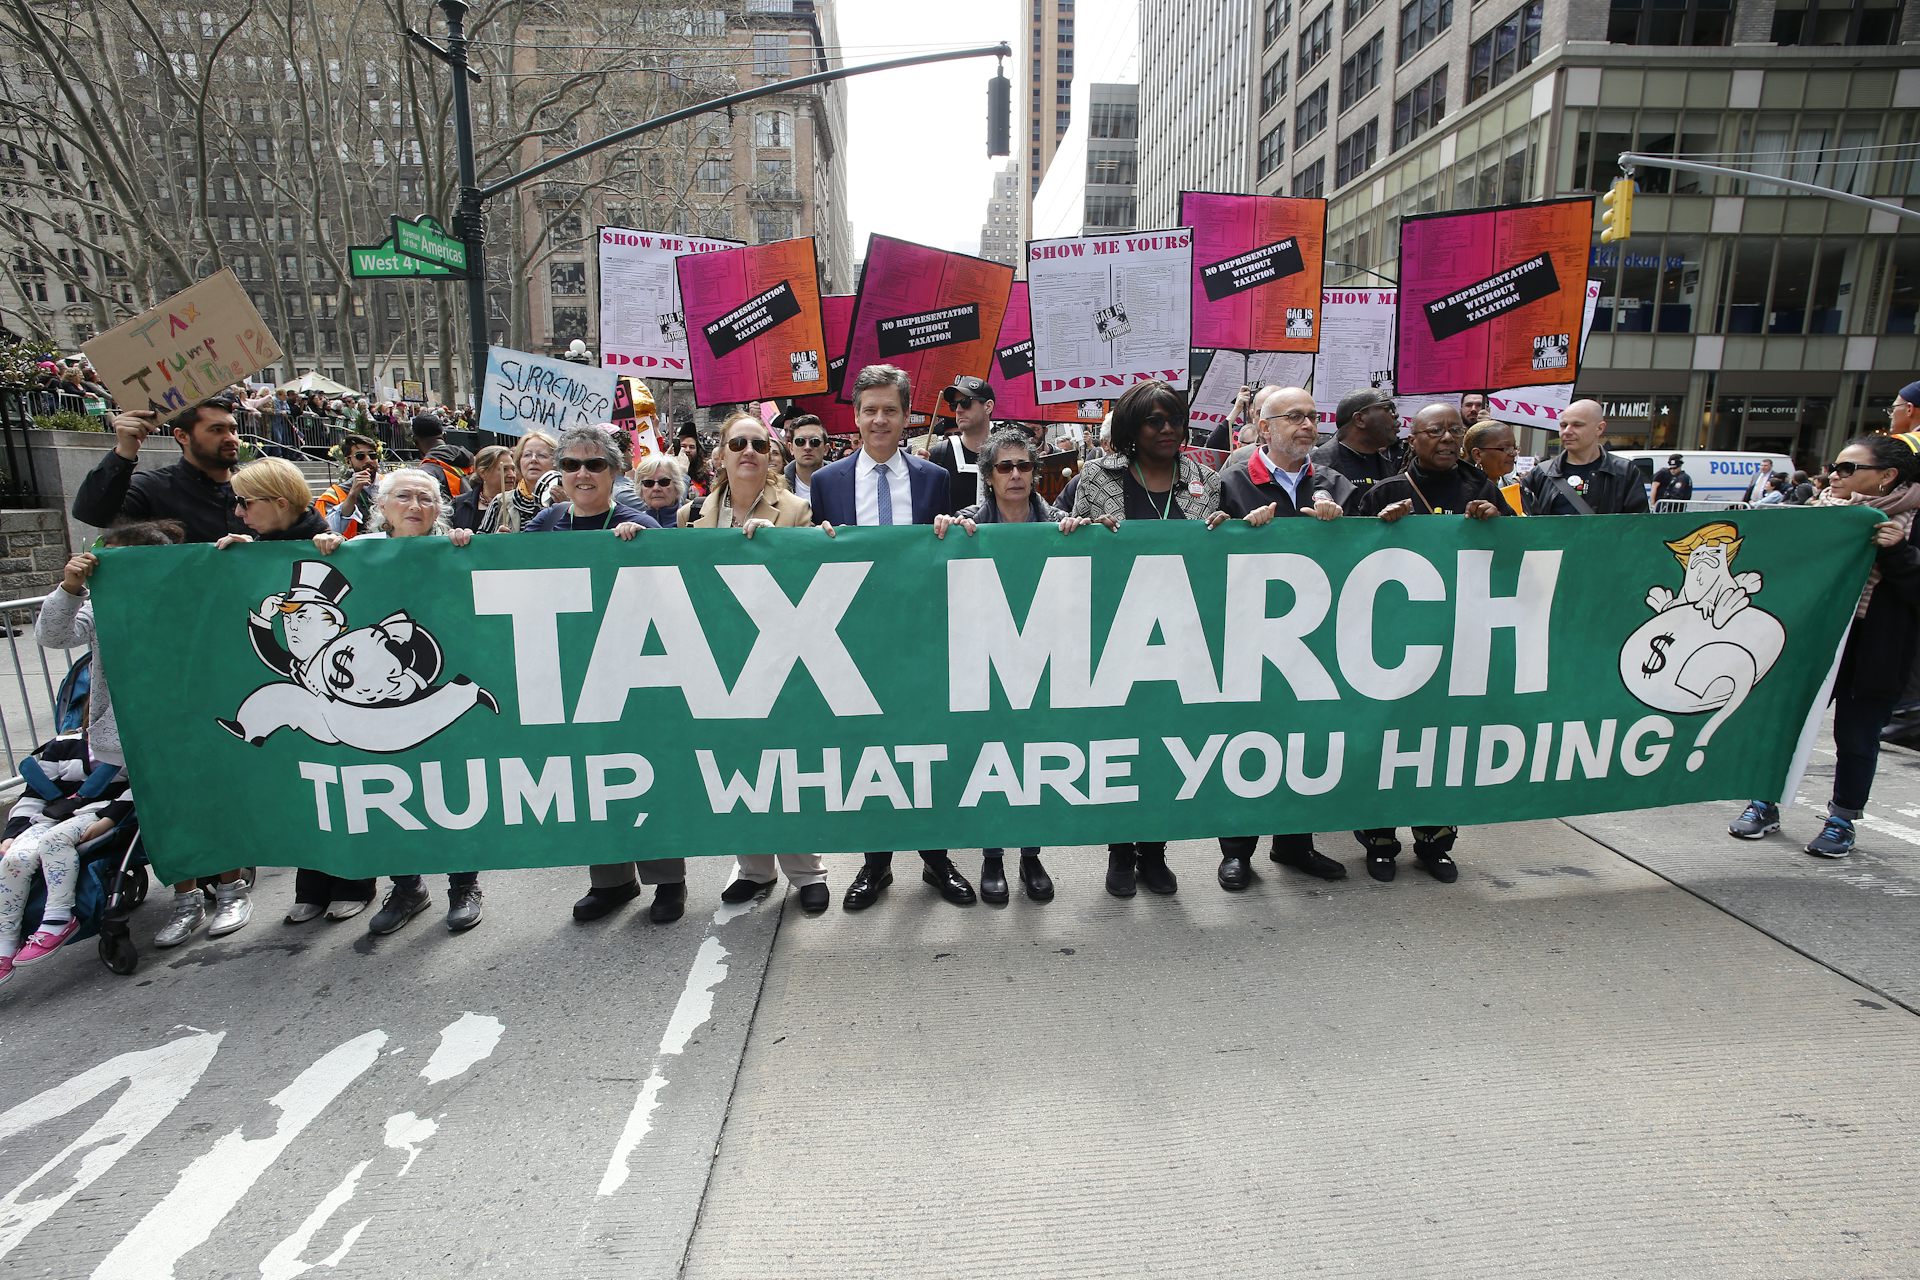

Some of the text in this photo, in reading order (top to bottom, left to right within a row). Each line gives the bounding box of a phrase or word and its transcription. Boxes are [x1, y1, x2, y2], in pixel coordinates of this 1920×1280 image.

[402, 228, 421, 241] Avenue
[602, 232, 653, 249] SHOW
[659, 238, 683, 252] ME
[409, 240, 418, 250] the
[421, 235, 463, 263] Americas
[1031, 234, 1190, 261] SHOW ME YOURS
[359, 255, 400, 271] West
[1205, 240, 1293, 277] NO REPRESENTATION
[1232, 258, 1272, 278] WITHOUT
[1233, 268, 1276, 288] TAXATION
[1430, 257, 1544, 314] NO REPRESENTATION
[1322, 292, 1372, 304] SHOW
[1464, 282, 1516, 311] WITHOUT
[707, 284, 786, 335] NO REPRESENTATION
[1094, 303, 1124, 324] GAG IS
[1287, 308, 1313, 319] GAG IS
[1466, 292, 1521, 322] TAXATION
[659, 311, 684, 326] GAG IS
[731, 306, 768, 332] WITHOUT
[735, 315, 774, 341] TAXATION
[882, 305, 974, 331] NO REPRESENTATION
[908, 321, 950, 337] WITHOUT
[908, 331, 952, 347] TAXATION
[1100, 322, 1131, 341] WATCHING
[1286, 328, 1312, 337] WATCHING
[1533, 334, 1569, 349] GAG IS
[605, 353, 687, 370] DON
[790, 350, 818, 363] GAG IS
[1001, 349, 1013, 358] NO
[1532, 357, 1568, 369] WATCHING
[792, 371, 819, 381] WATCHING
[1040, 369, 1186, 393] DONNY
[1371, 371, 1388, 381] GAG
[497, 361, 609, 418] SURRENDER
[1488, 397, 1564, 420] NNY
[1619, 402, 1650, 417] MANGE
[471, 547, 1563, 726] TAX MARCH
[298, 753, 655, 836] TRUMP,
[695, 744, 948, 814] WHAT
[958, 738, 1139, 808] ARE
[1162, 731, 1344, 801] YOU
